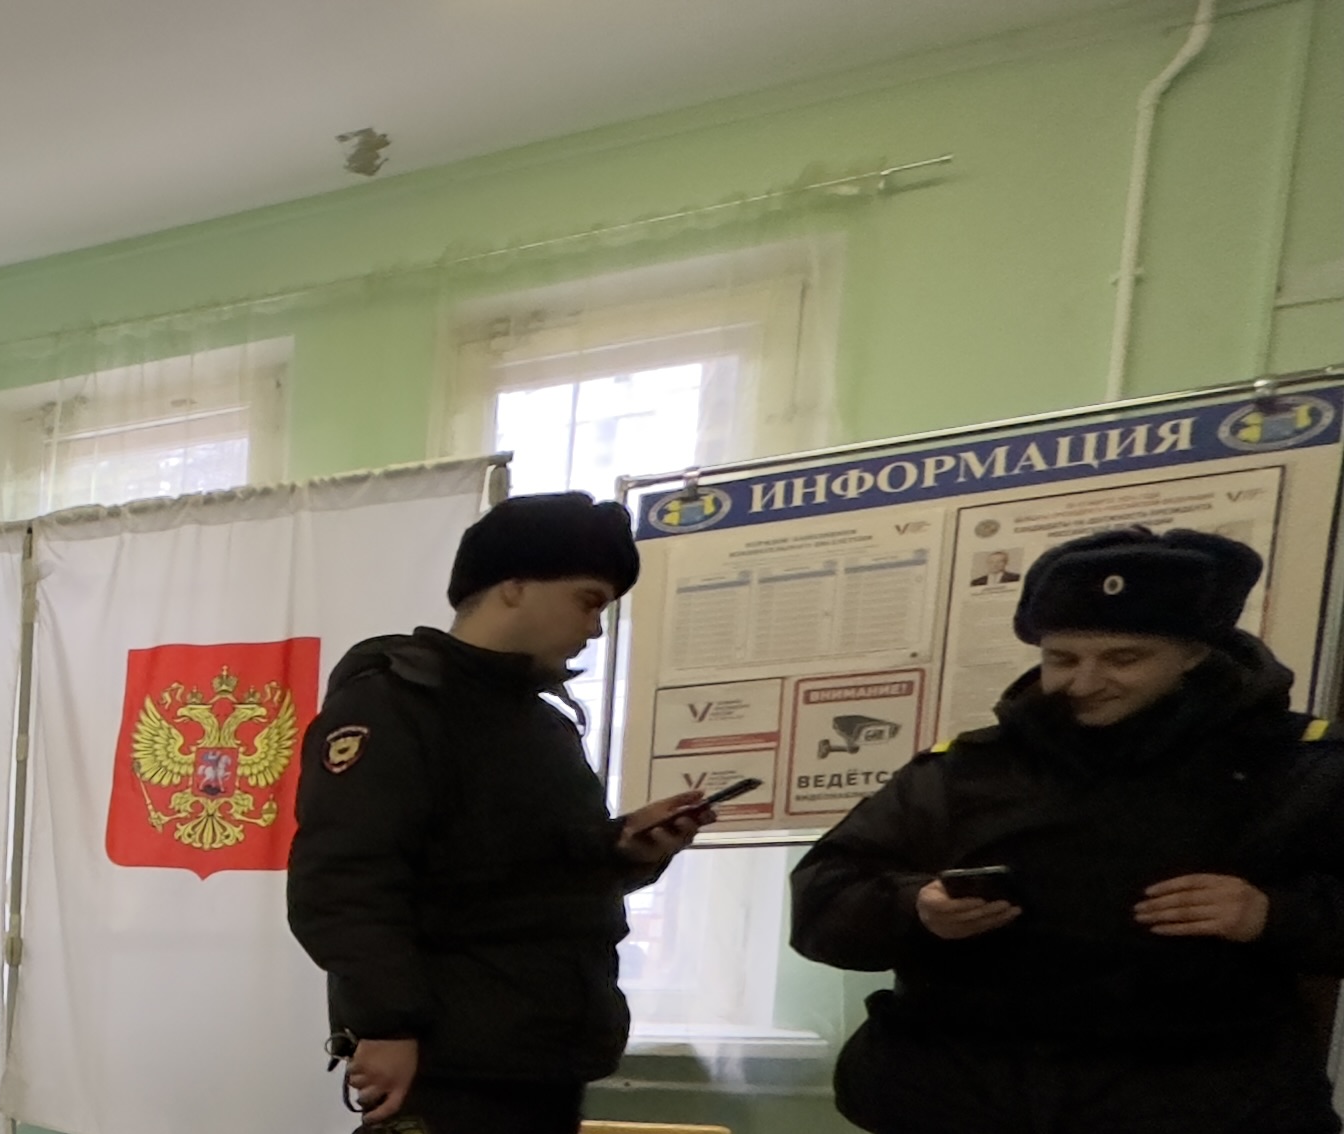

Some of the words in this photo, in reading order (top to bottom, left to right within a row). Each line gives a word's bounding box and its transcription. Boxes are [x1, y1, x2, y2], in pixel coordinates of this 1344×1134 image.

[749, 416, 1198, 514] ИНФОРМАЦИЯ
[810, 683, 908, 701] ВНИМАНИЕ!
[797, 769, 894, 789] ВЕДЁТС
